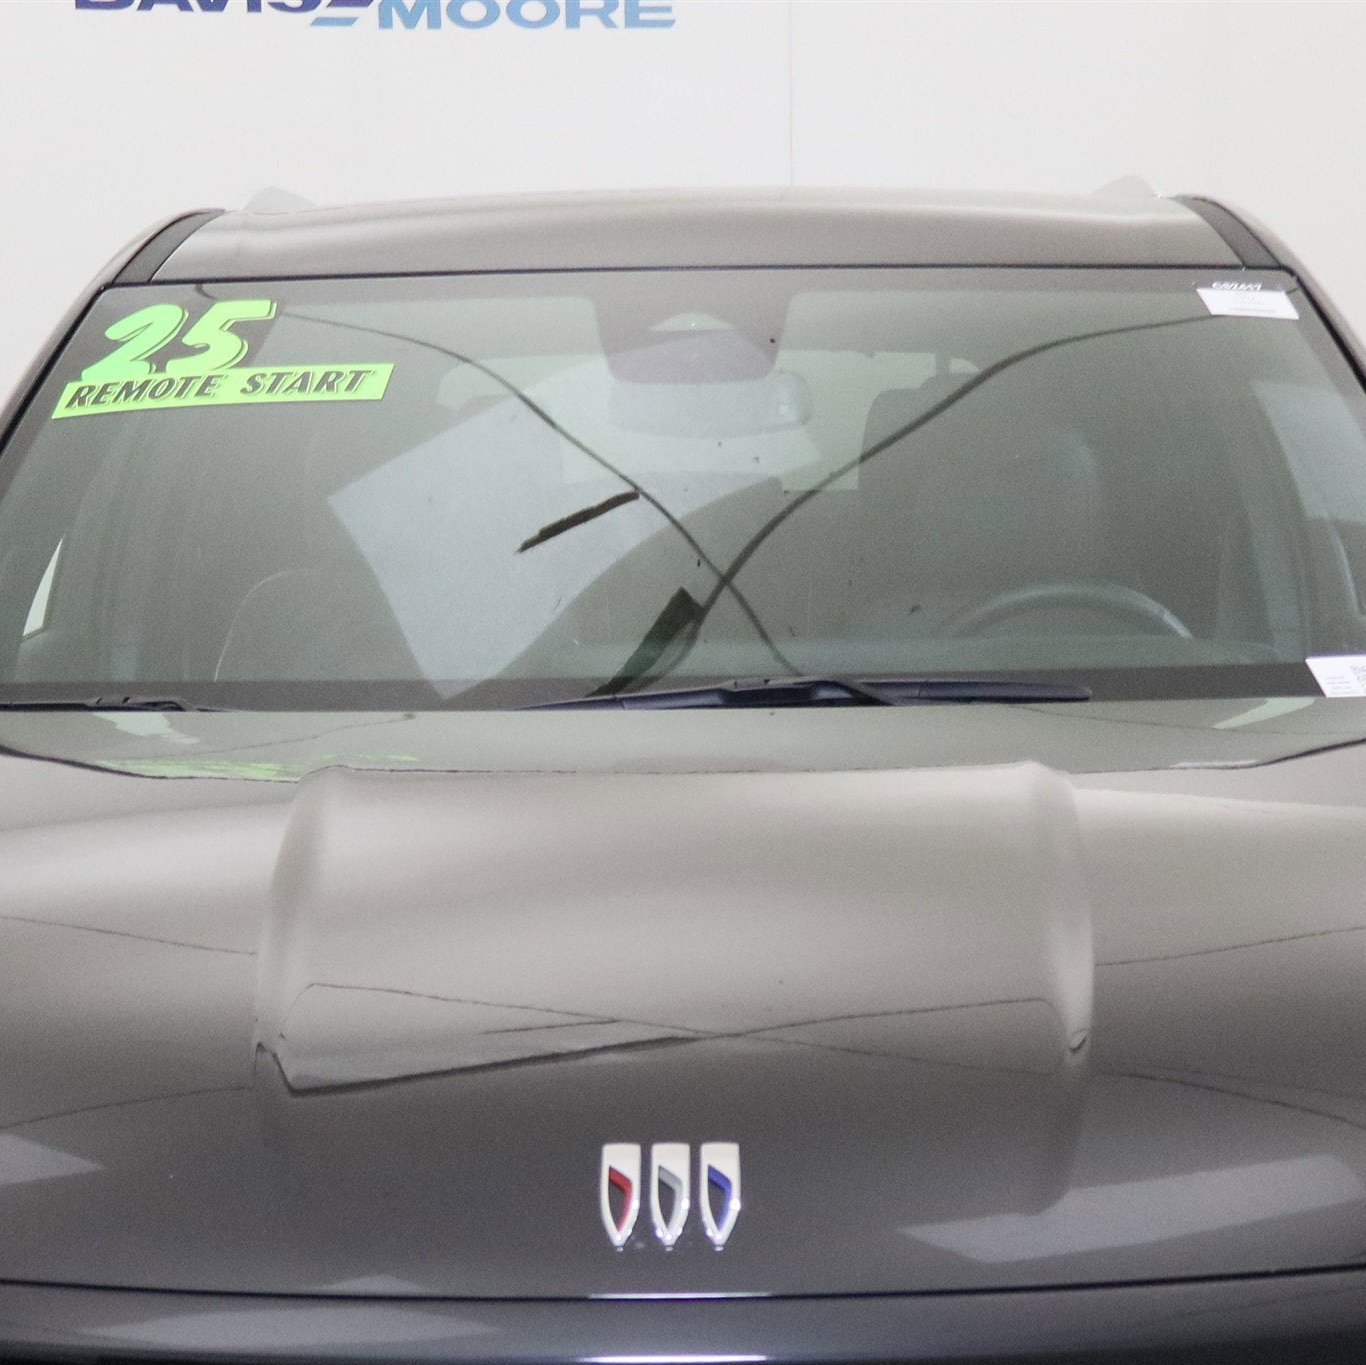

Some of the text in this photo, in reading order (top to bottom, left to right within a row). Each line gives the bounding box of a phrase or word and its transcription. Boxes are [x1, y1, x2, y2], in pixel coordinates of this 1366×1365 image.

[378, 0, 676, 29] MOORE
[81, 300, 278, 381] 25
[64, 369, 375, 411] REMOTE START
